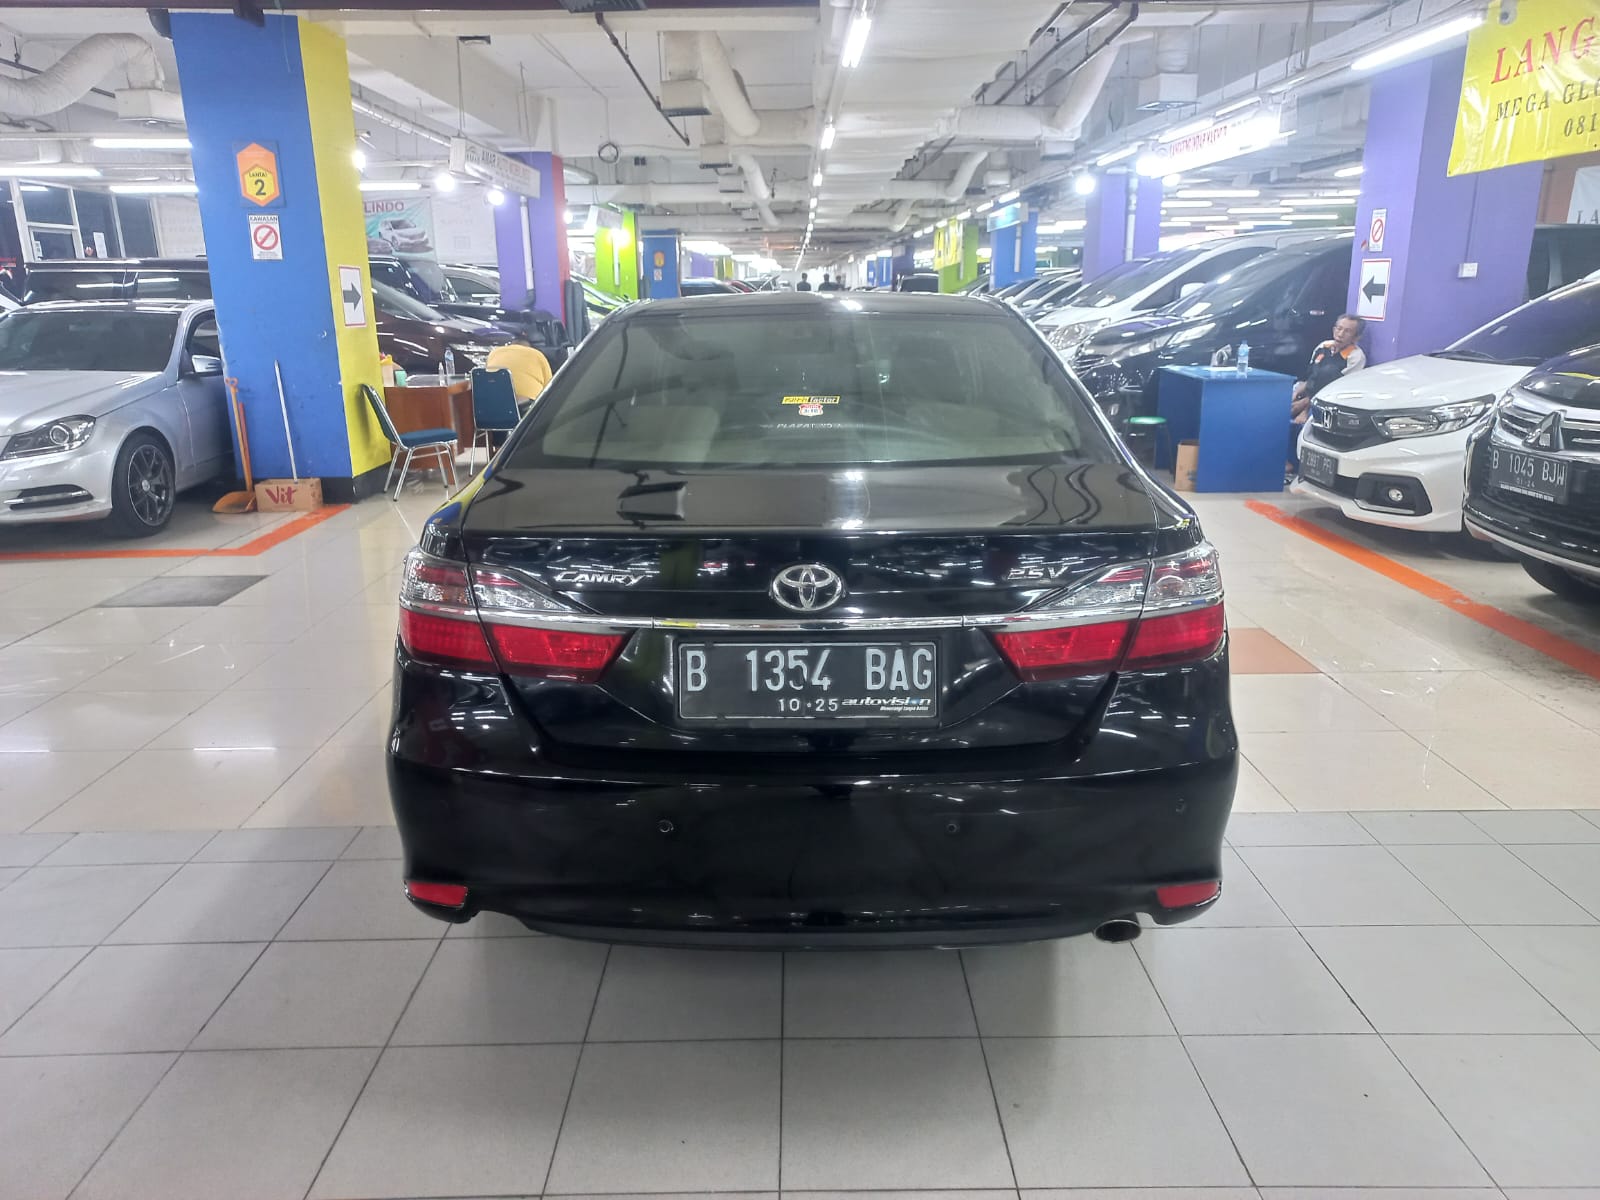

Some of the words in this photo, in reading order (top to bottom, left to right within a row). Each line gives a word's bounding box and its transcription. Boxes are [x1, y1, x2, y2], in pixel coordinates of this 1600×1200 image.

[1491, 16, 1595, 84] LANG
[1495, 89, 1549, 122] MEGA
[1564, 112, 1598, 137] 081
[254, 179, 267, 196] 2
[364, 201, 405, 214] LINDO
[1492, 450, 1500, 469] B
[1509, 453, 1535, 478] 1045
[1542, 460, 1565, 486] BJW
[264, 484, 297, 505] Vit
[553, 571, 647, 586] CAMRY
[686, 650, 708, 691] B
[745, 649, 832, 692] 1354
[866, 648, 933, 691] BAG
